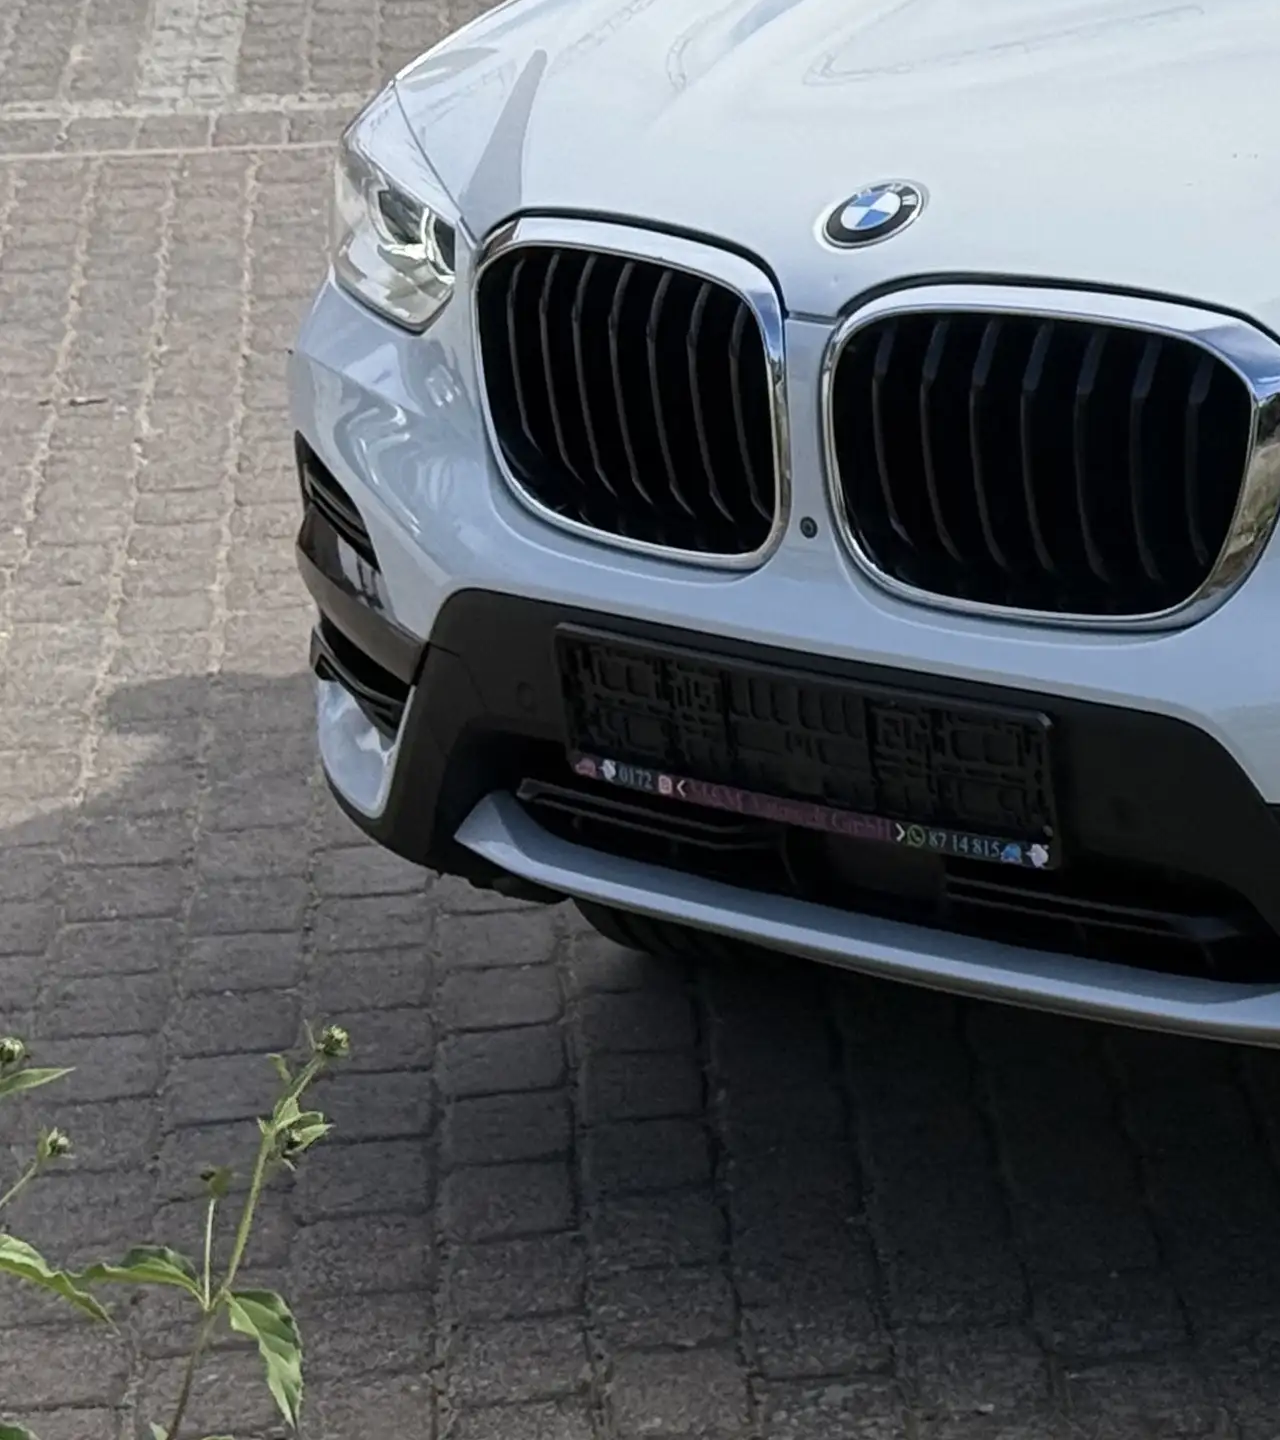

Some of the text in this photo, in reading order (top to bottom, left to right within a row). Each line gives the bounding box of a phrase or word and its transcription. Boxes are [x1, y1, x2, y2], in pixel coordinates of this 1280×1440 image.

[618, 765, 654, 791] 0172
[929, 829, 947, 848] 87
[952, 834, 969, 853] 14
[972, 839, 1001, 858] 815
